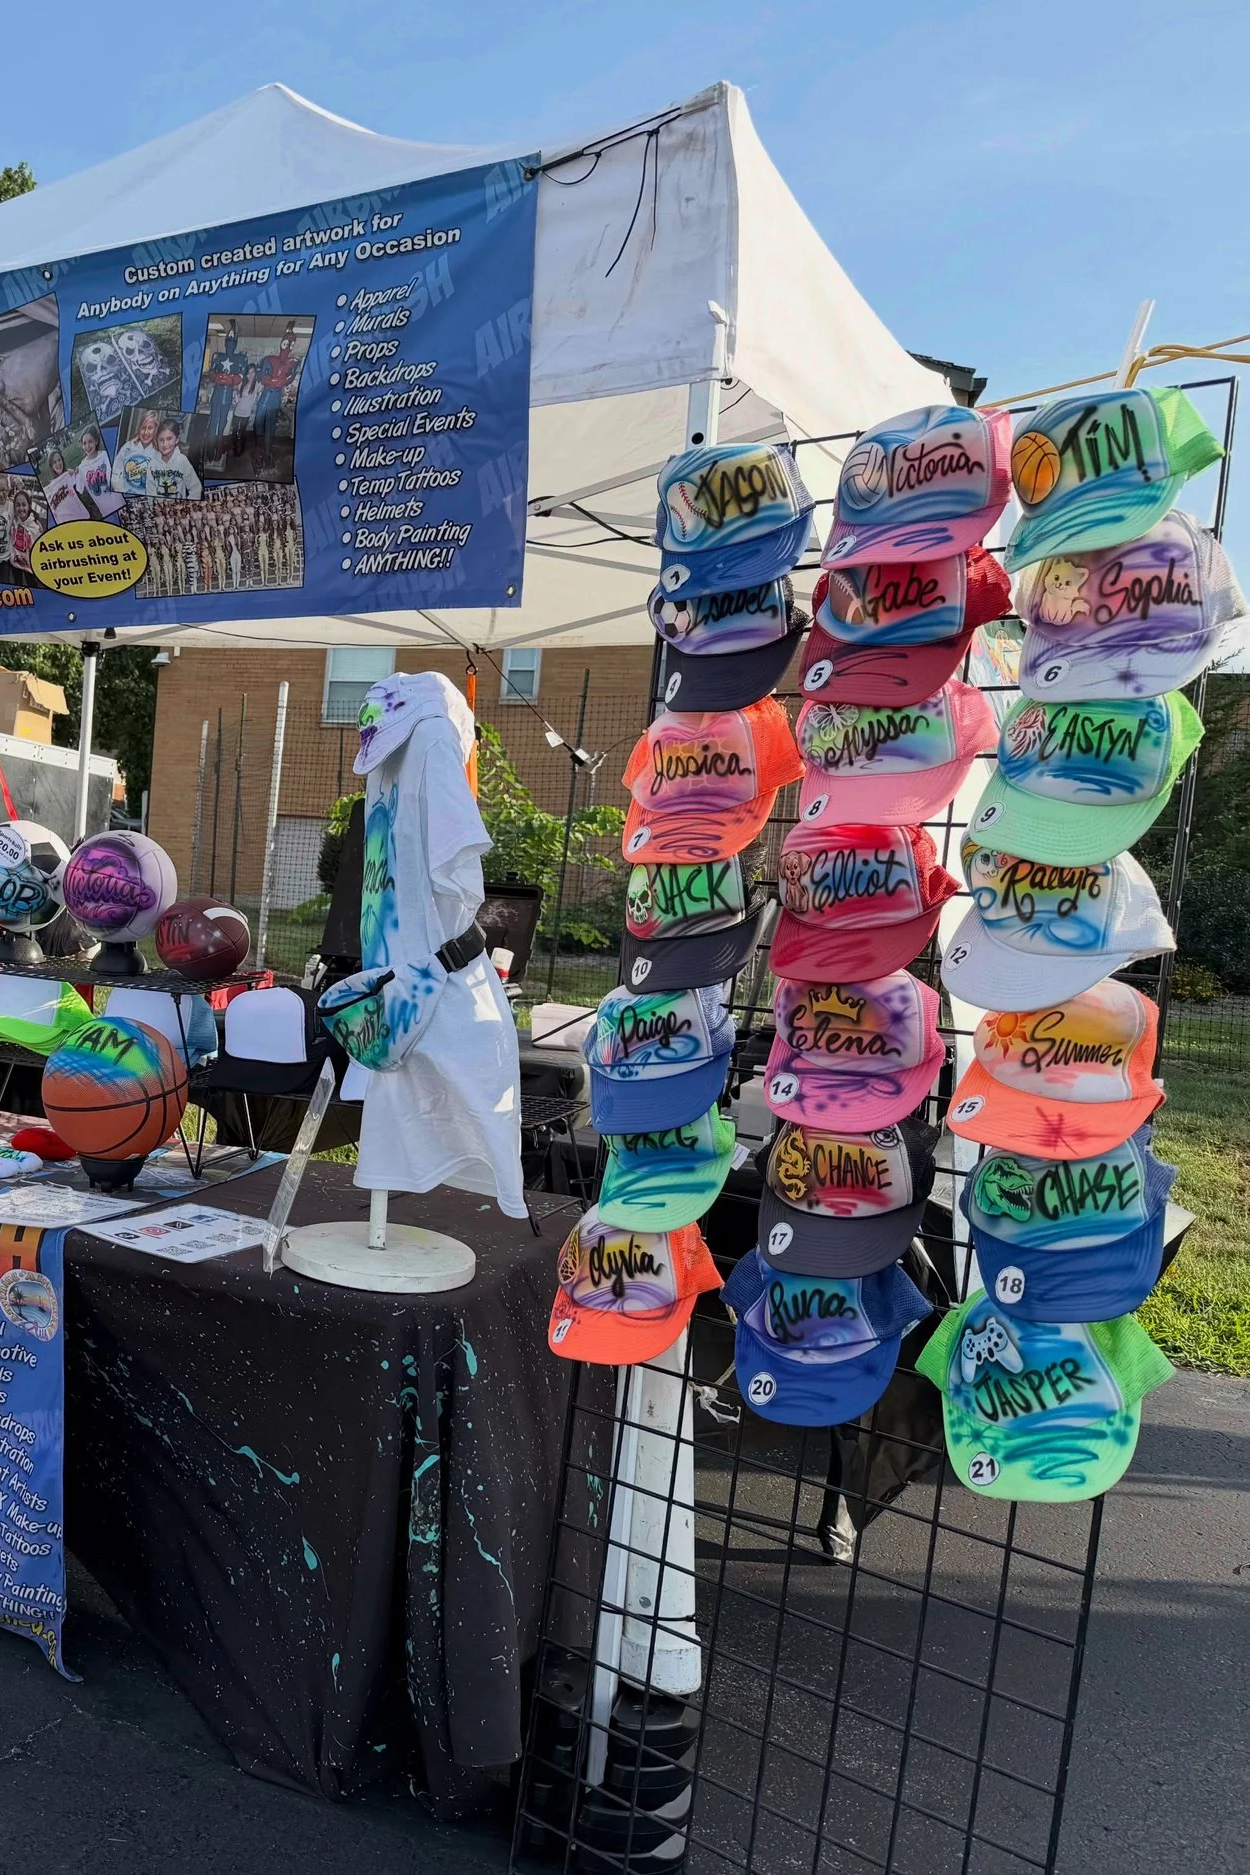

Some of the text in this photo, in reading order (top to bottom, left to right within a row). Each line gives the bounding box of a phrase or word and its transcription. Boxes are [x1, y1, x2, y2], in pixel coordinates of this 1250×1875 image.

[124, 256, 196, 287] Custom
[199, 236, 278, 271] created
[281, 218, 365, 254] artwork
[371, 211, 404, 234] for
[77, 226, 463, 321] Anybody on Anything for Any Occasion
[350, 278, 419, 313] Apparel
[347, 307, 411, 336] Murals
[344, 340, 399, 363] Props
[344, 360, 438, 390] Backdrops
[343, 385, 442, 416] Illustration
[346, 406, 476, 447] Special Events
[350, 445, 425, 469] Make-up
[876, 431, 986, 498] Victoria
[351, 466, 462, 498] Temp Tattoos
[354, 496, 424, 522] Helmets
[38, 533, 130, 554] Ask us about
[354, 520, 472, 550] Body Painting
[831, 540, 848, 557] 2
[39, 550, 138, 572] airbrushing at
[354, 548, 454, 575] ANYTHING!!
[52, 567, 132, 590] your Event!
[861, 562, 946, 625] Gabe
[1094, 557, 1204, 626] Sophia
[668, 677, 679, 695] 4
[810, 666, 826, 683] 5
[1043, 664, 1063, 682] 6
[824, 711, 930, 767] Alyssa
[1038, 705, 1148, 764] EASTYN
[649, 738, 754, 797] Jessica
[807, 800, 823, 816] 8
[979, 805, 997, 823] 9
[633, 832, 646, 849] 7
[650, 861, 736, 921] JACK
[809, 848, 912, 914] Elliot
[633, 960, 649, 978] 10
[949, 945, 968, 965] 12
[617, 1004, 692, 1059] Paige
[786, 1004, 903, 1058] Elena
[1020, 1010, 1124, 1073] Summer
[771, 1079, 793, 1097] 14
[956, 1100, 979, 1116] 15
[812, 1143, 893, 1191] CHANCE
[1035, 1158, 1142, 1222] CHASE
[769, 1231, 788, 1247] 17
[999, 1274, 1023, 1296] 18
[768, 1280, 856, 1344] Luna
[751, 1379, 774, 1397] 20
[972, 1357, 1097, 1422] JASPER
[970, 1458, 997, 1479] 21
[8, 1472, 48, 1512] Artists
[0, 1524, 52, 1556] Tattoos
[3, 1573, 64, 1614] Painting
